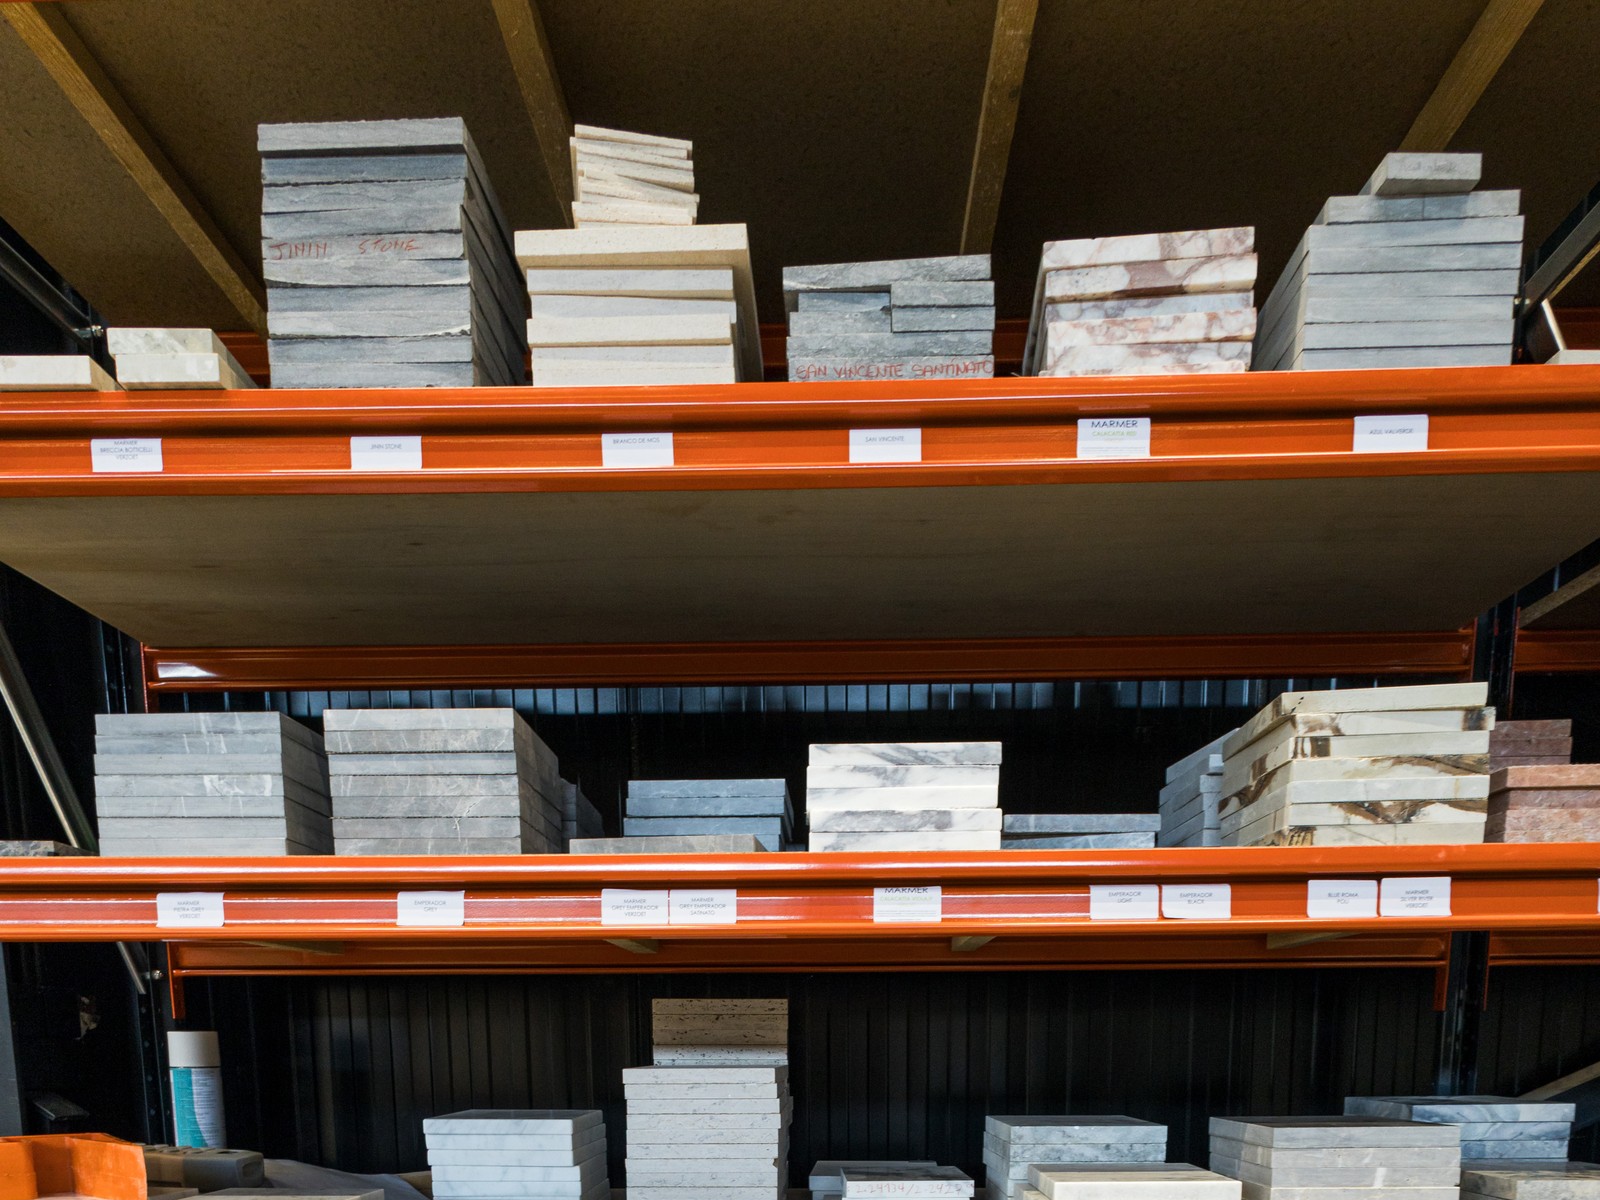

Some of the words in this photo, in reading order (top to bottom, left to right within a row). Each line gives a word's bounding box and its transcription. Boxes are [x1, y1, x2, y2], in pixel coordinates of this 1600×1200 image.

[358, 238, 422, 255] STONE
[795, 362, 828, 378] SAN
[1090, 419, 1138, 429] MARMER
[612, 437, 639, 445] BRANCO
[639, 436, 647, 444] DE
